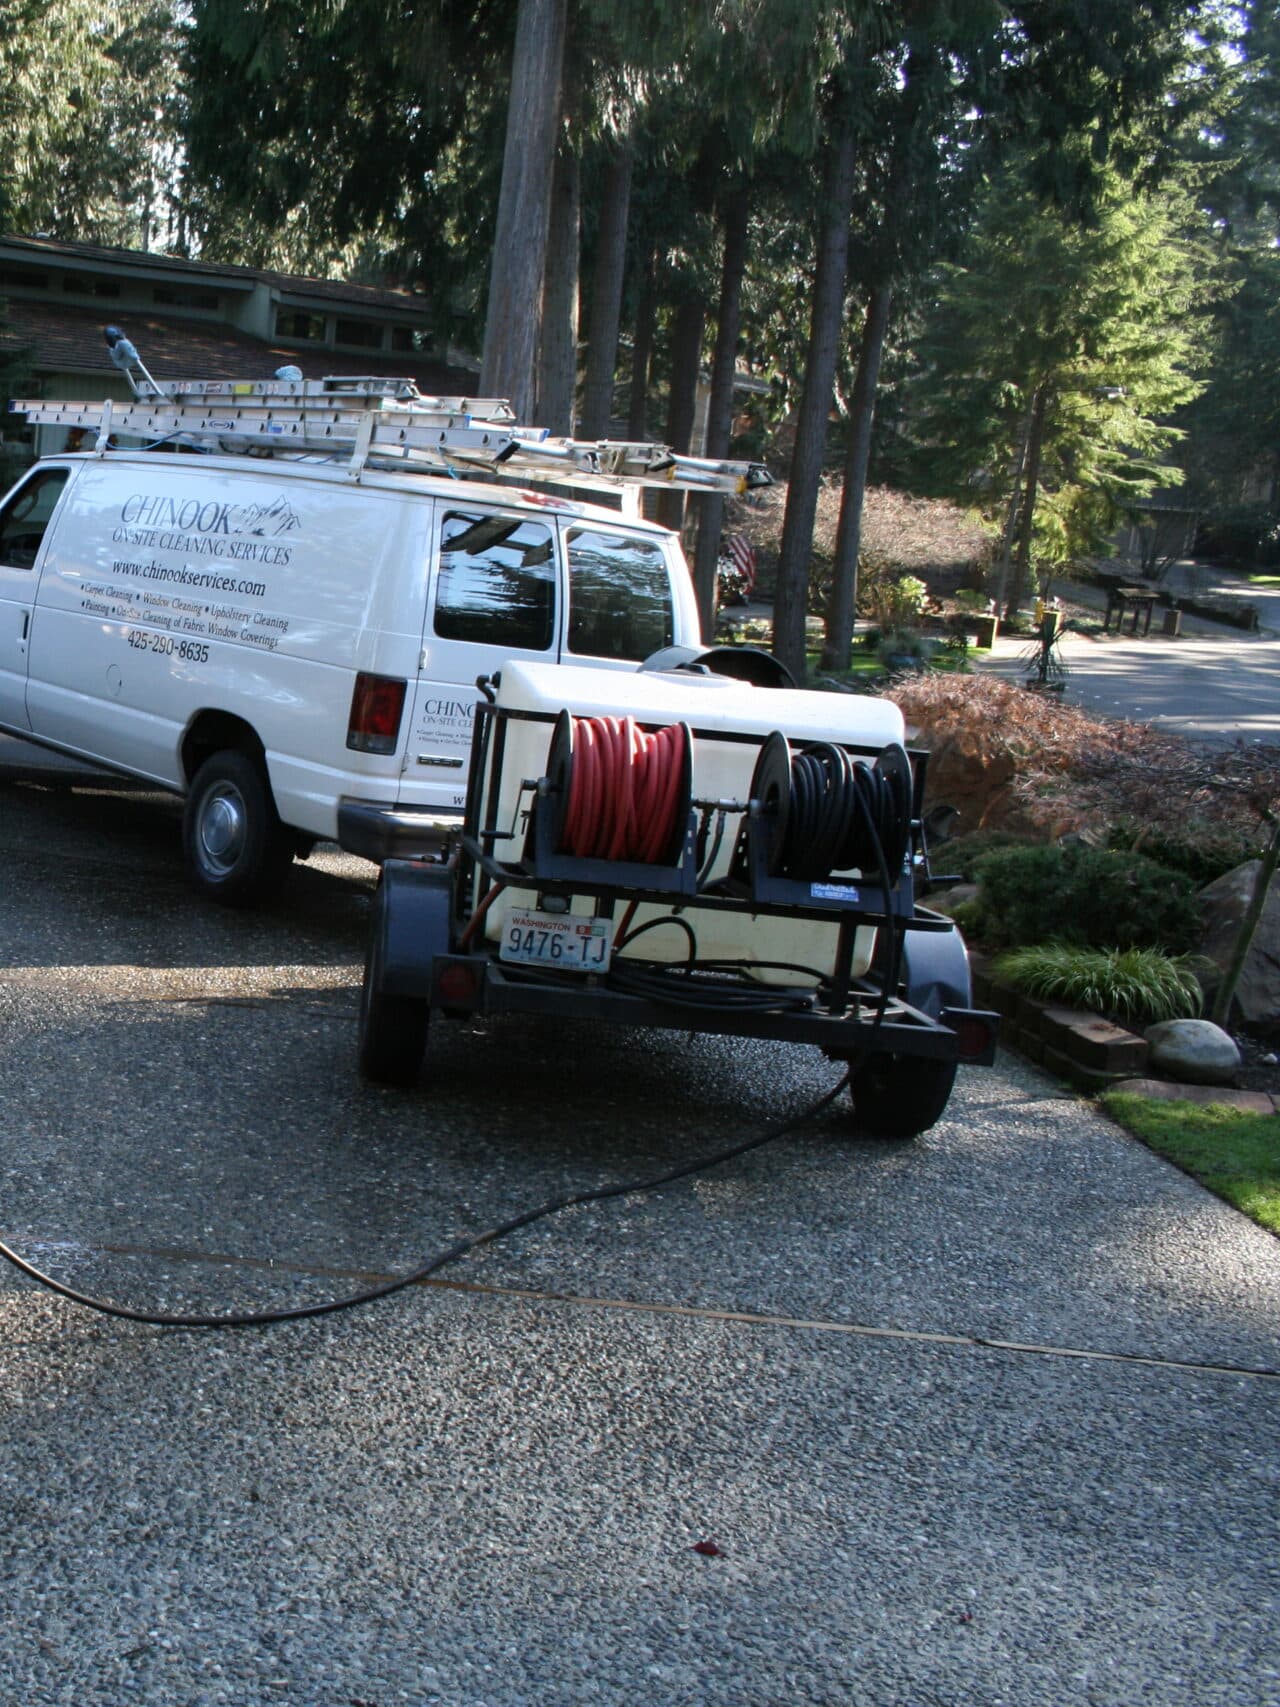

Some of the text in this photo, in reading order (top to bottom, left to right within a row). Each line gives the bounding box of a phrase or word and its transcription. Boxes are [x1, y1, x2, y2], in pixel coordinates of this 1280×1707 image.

[121, 494, 239, 534] CHINOOK
[112, 527, 293, 566] ON-SITE CLEANING SERVICES
[112, 560, 266, 597] www.chinookservices.com
[142, 610, 172, 628] Cleaning
[173, 616, 182, 627] of
[183, 617, 206, 632] Fabric
[208, 622, 238, 638] Window
[240, 629, 279, 650] Coverings
[171, 597, 203, 617] Cleaning
[210, 604, 251, 625] Upholstery
[253, 612, 289, 633] Cleaning
[127, 630, 210, 663] 425-290-8635
[512, 917, 571, 931] WASHINGTON
